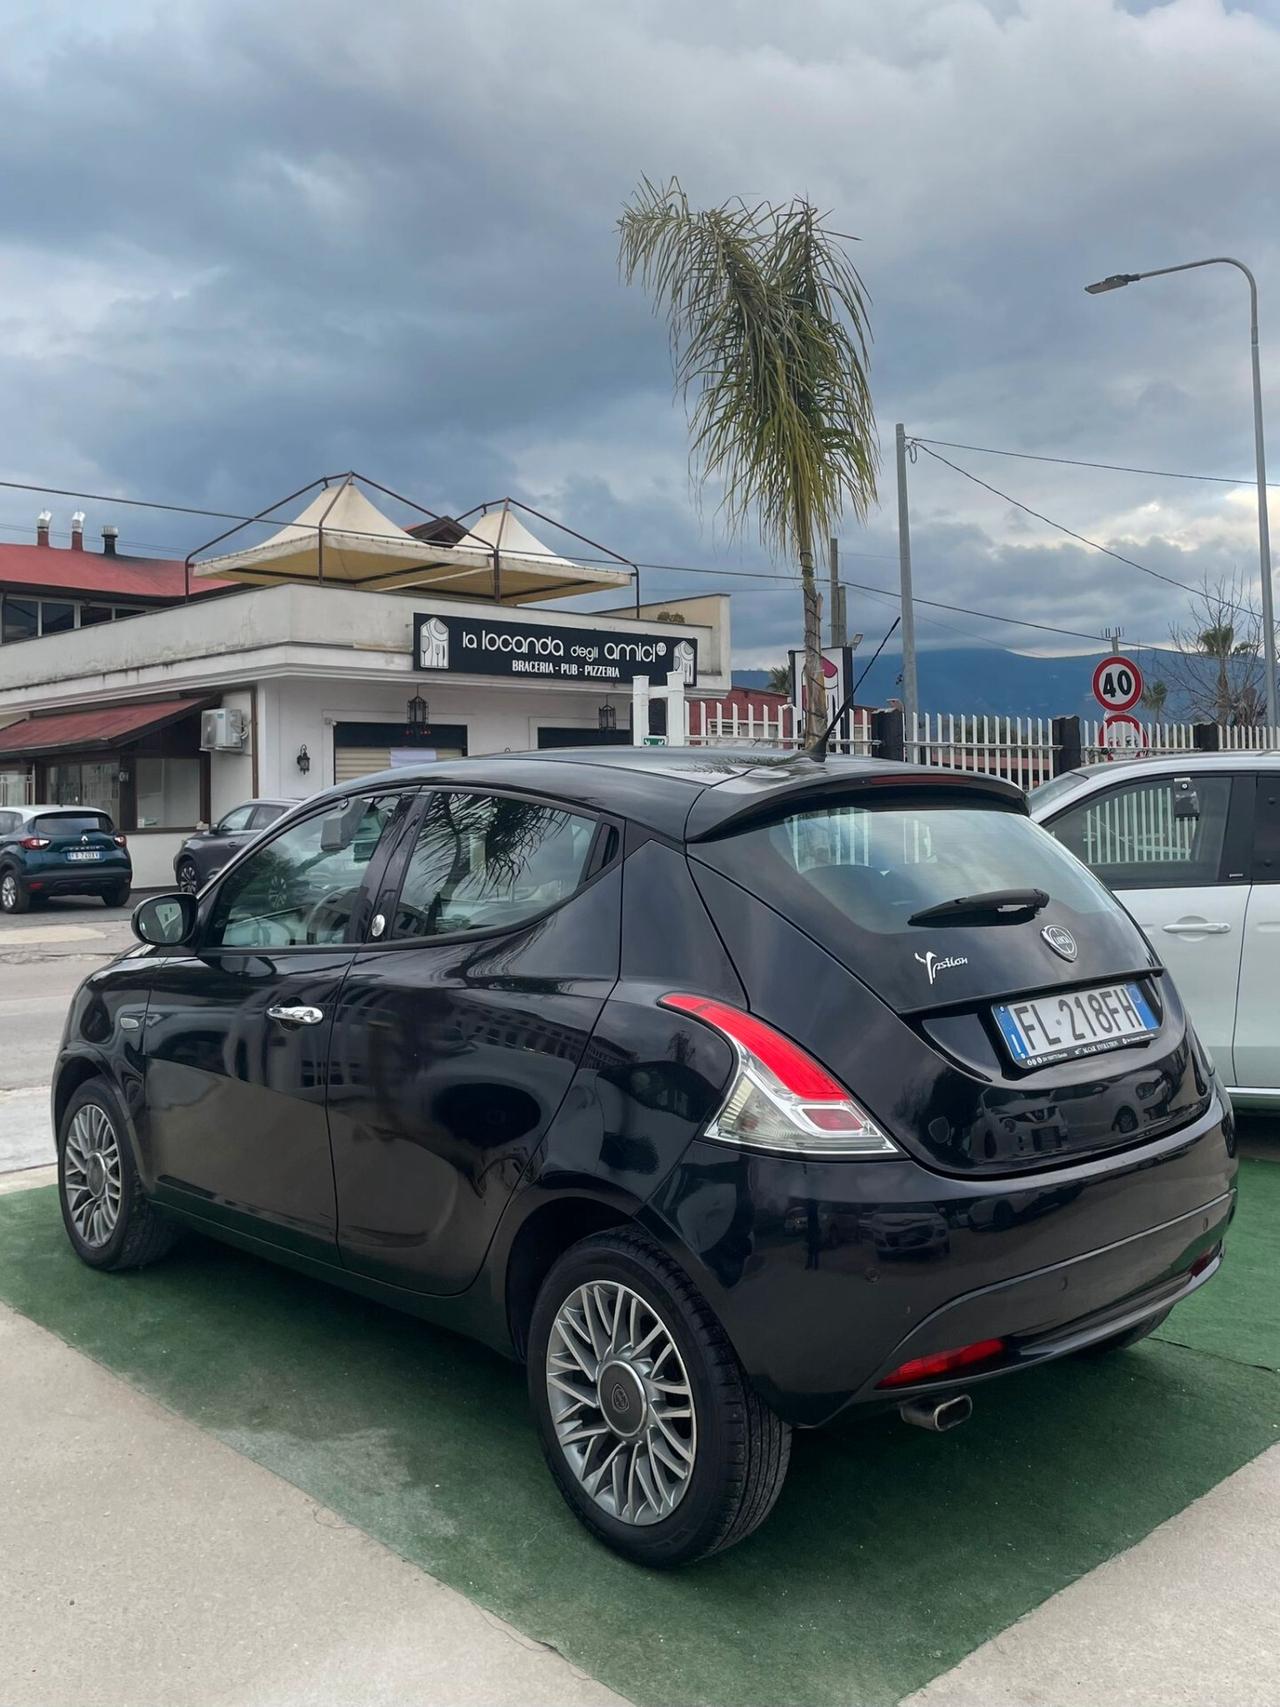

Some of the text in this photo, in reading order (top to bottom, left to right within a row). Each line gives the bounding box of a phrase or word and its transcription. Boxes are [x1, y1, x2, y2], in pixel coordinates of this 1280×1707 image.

[462, 631, 477, 649] la
[482, 630, 564, 657] locanda
[571, 645, 598, 662] degli
[604, 642, 656, 663] amici
[512, 660, 554, 674] BRACERIA
[561, 663, 578, 675] PUB
[584, 665, 620, 678] PIZZERIA
[1103, 669, 1133, 698] 40
[914, 950, 968, 984] Ypsilon
